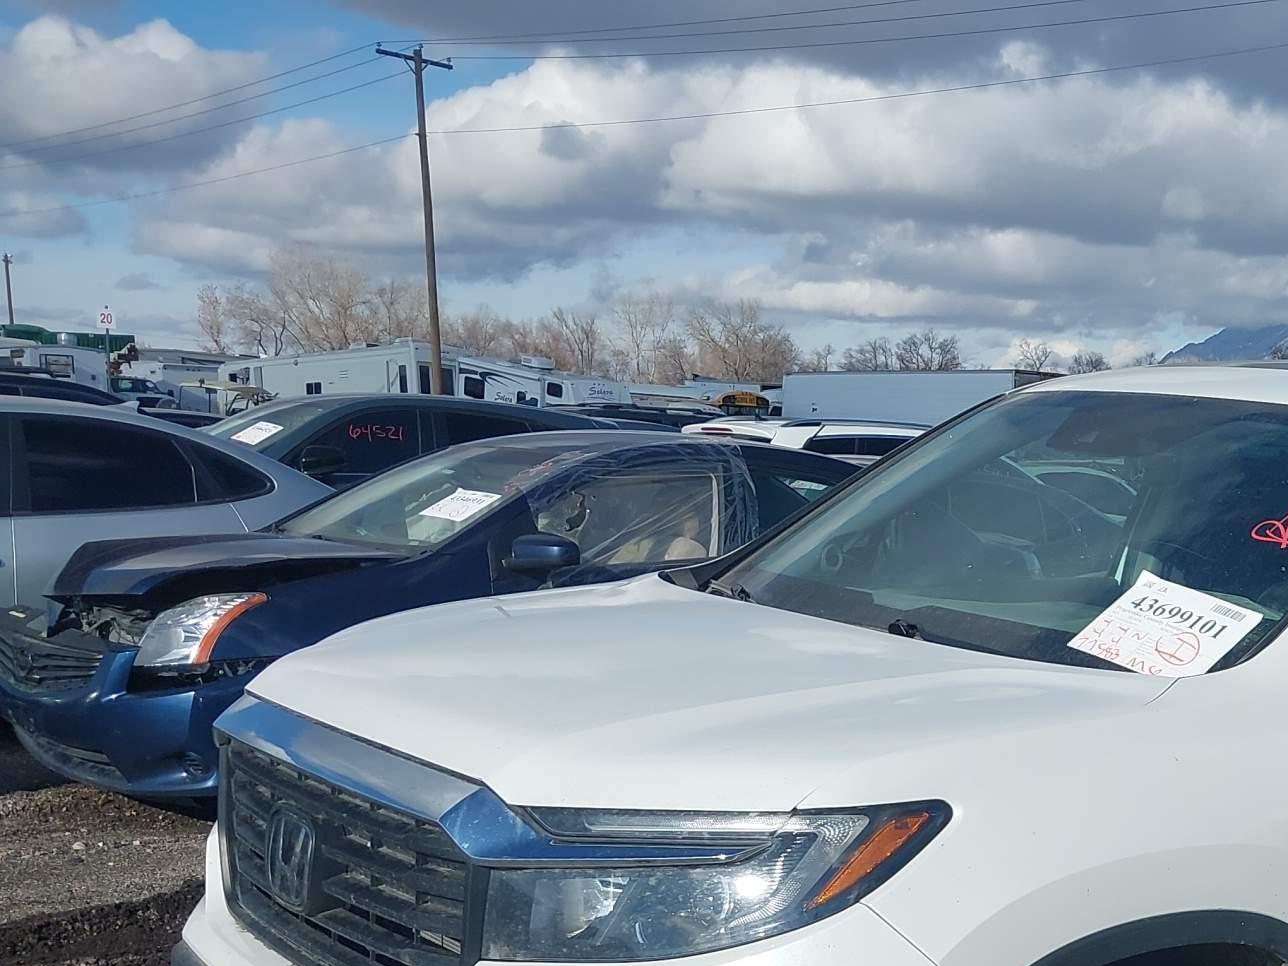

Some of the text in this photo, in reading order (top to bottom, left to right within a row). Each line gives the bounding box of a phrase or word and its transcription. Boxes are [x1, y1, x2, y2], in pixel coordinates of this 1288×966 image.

[100, 312, 113, 325] 20
[349, 424, 403, 442] 64521
[1130, 595, 1229, 640] 43699101
